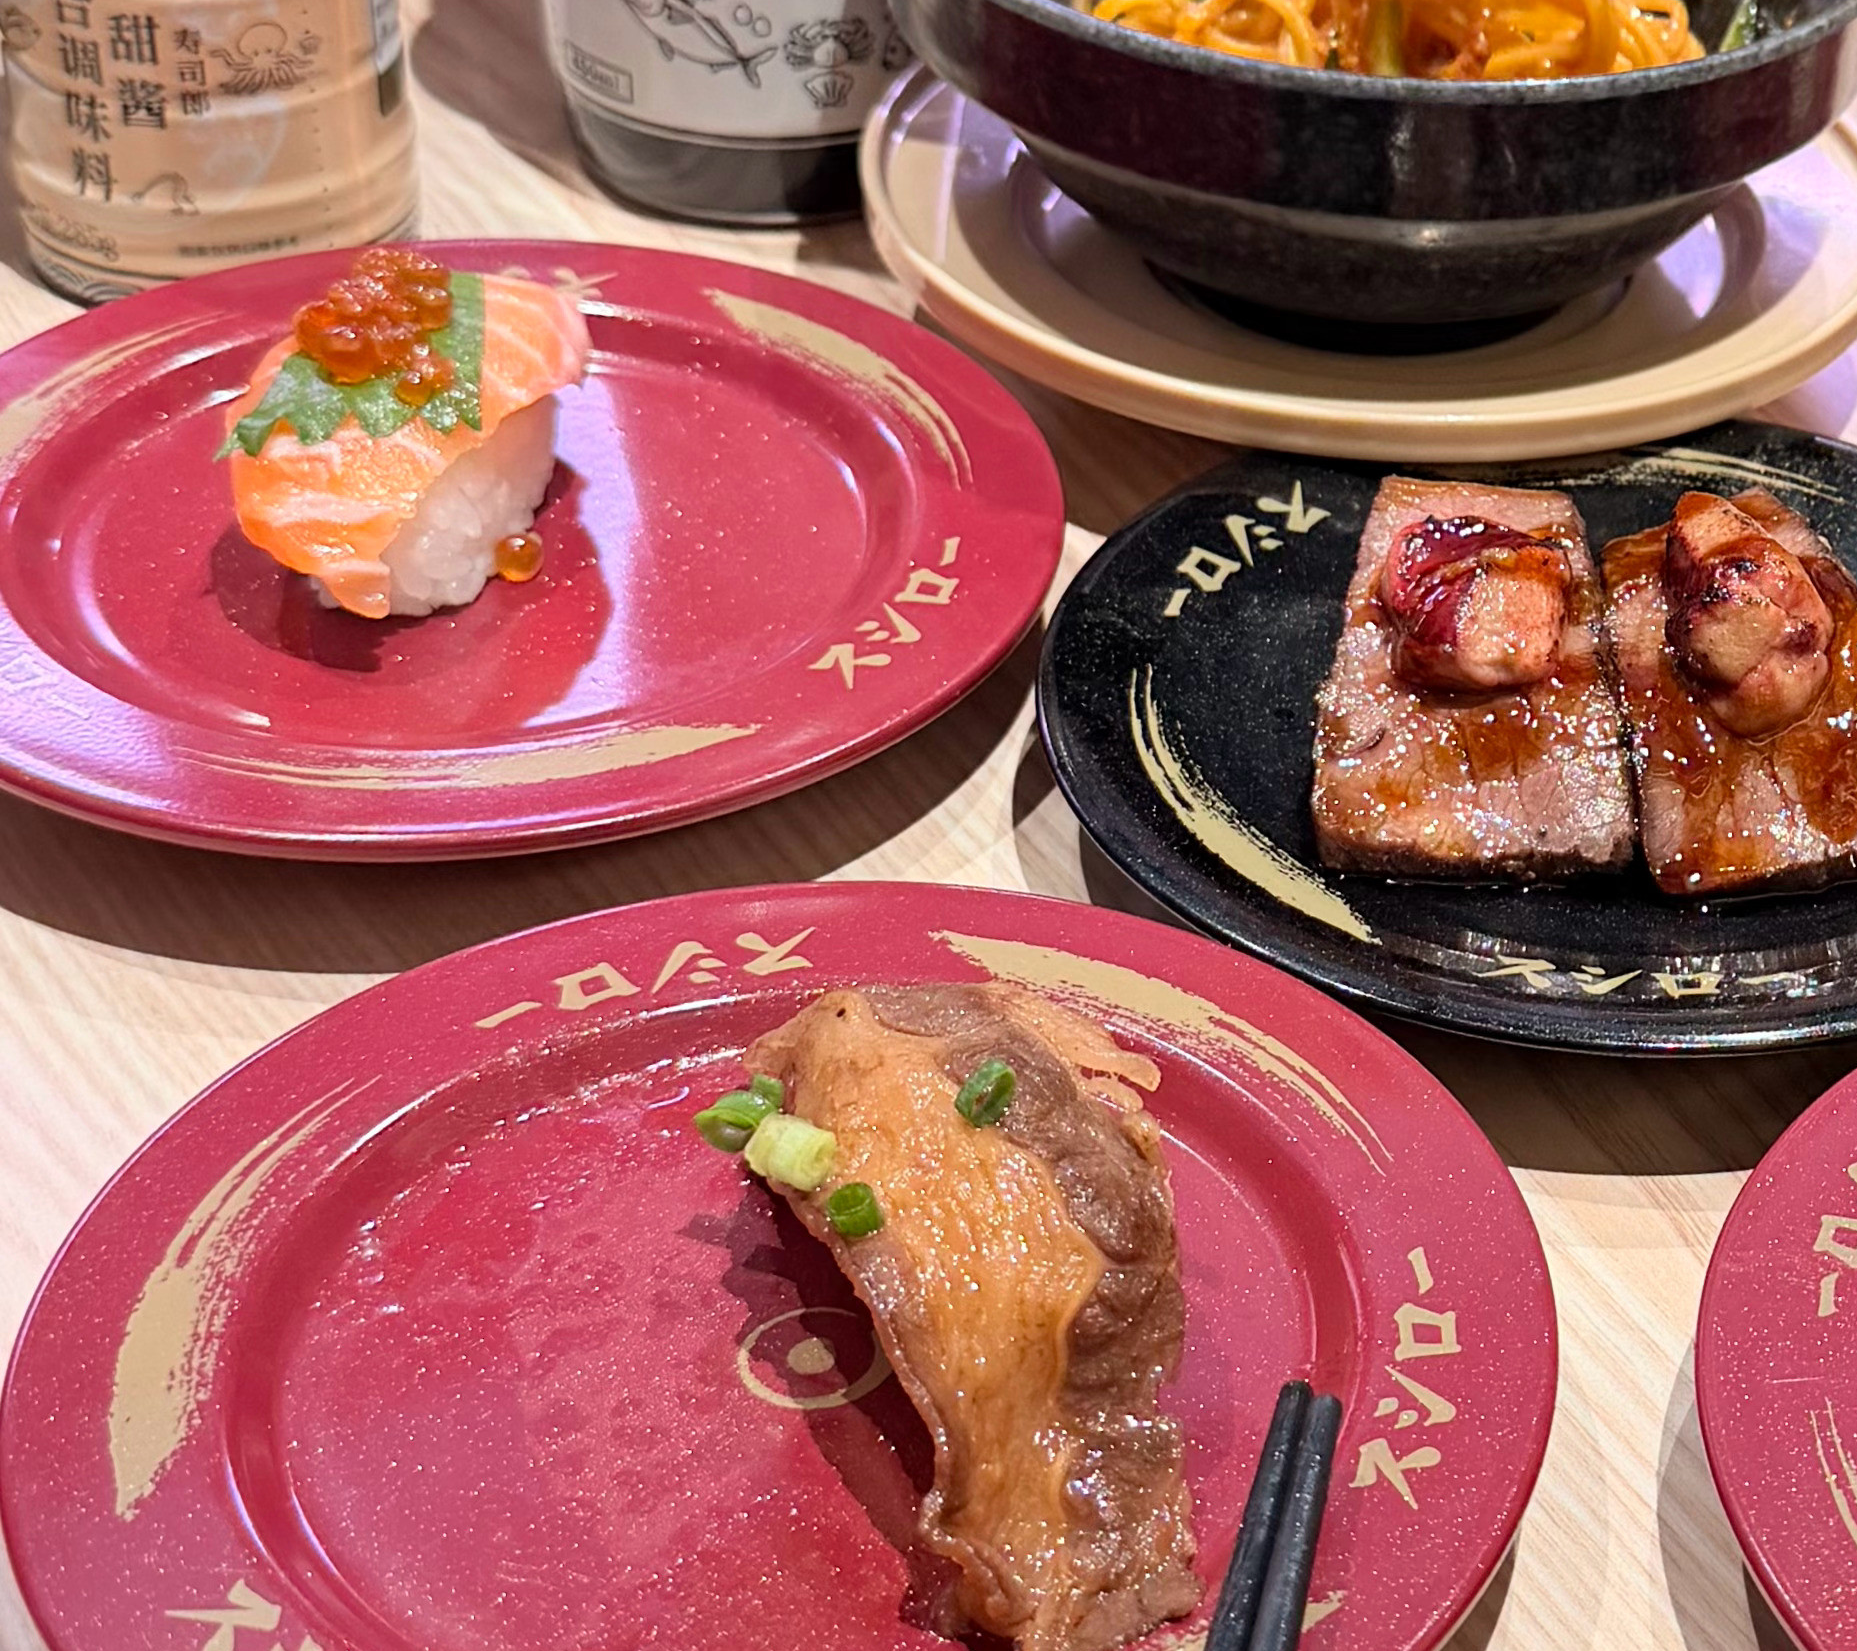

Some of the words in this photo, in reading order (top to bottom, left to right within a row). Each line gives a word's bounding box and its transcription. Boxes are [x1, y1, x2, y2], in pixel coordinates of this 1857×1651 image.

[108, 12, 168, 131] 甜酱
[173, 27, 213, 116] 寿司郎
[808, 536, 961, 690] スシロー
[1163, 479, 1332, 619] スシロー
[476, 928, 815, 1028] スシロー
[1352, 1247, 1462, 1511] スシロー
